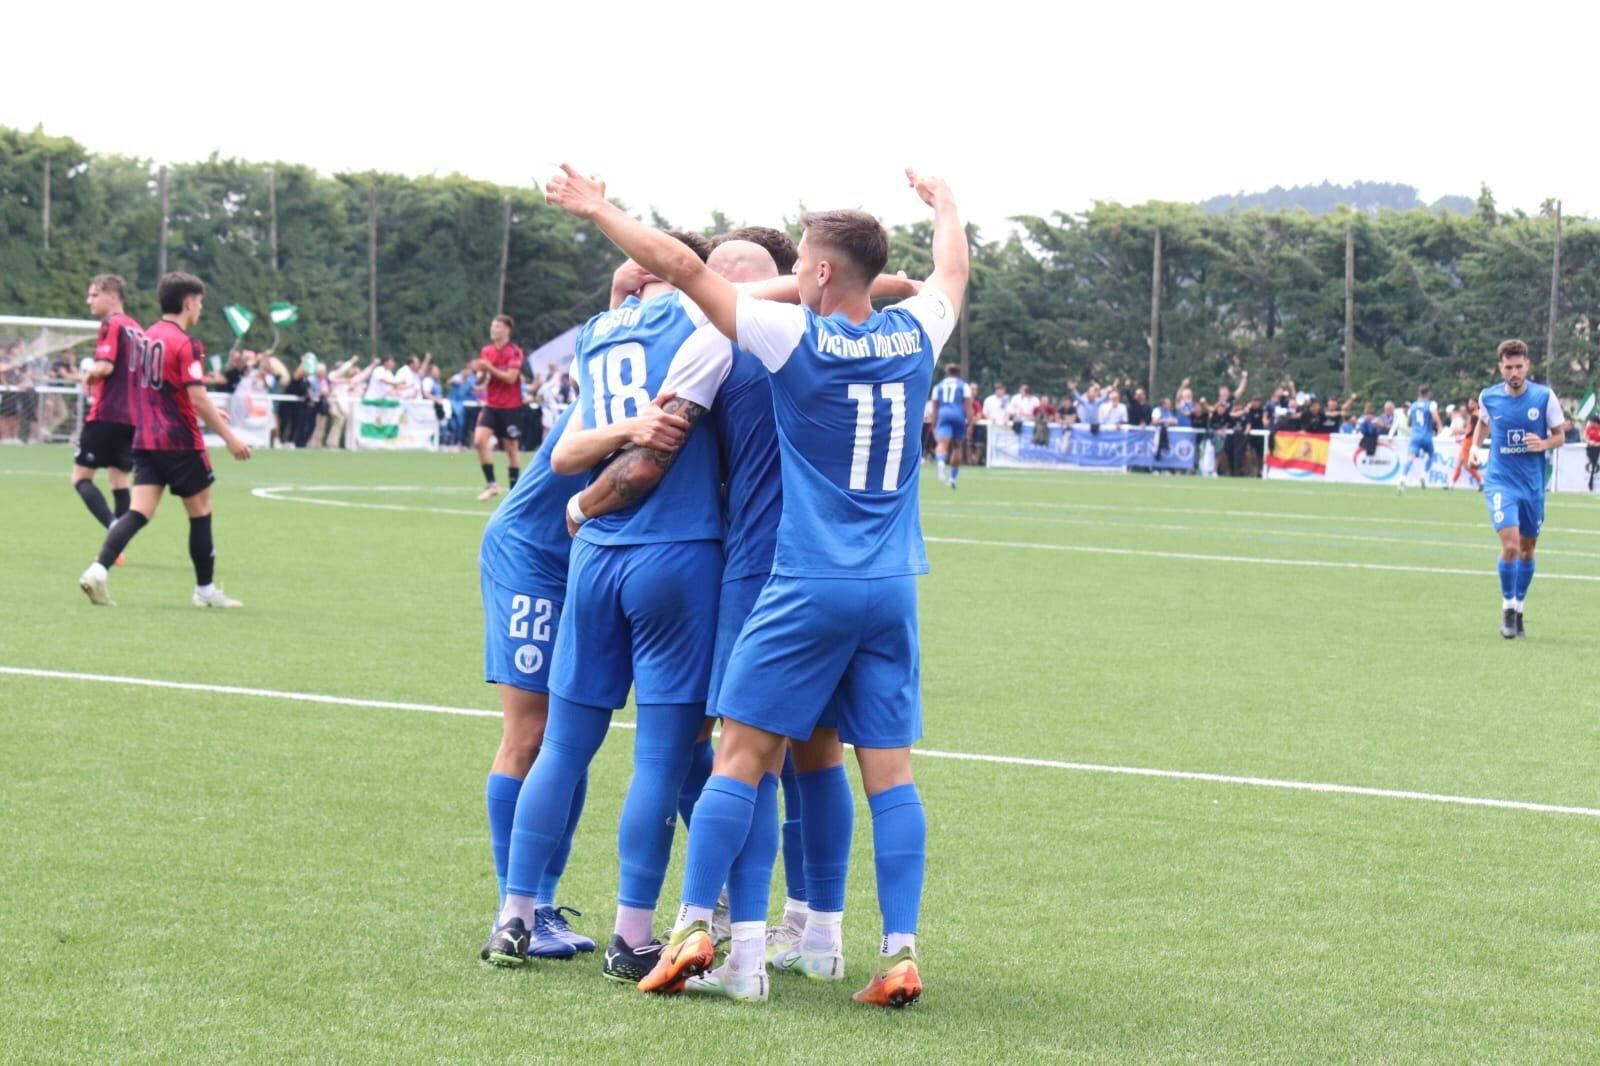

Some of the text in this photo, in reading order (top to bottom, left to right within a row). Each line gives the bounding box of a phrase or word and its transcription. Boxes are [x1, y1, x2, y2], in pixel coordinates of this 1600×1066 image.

[140, 336, 165, 390] 10
[817, 328, 870, 357] VICTOR
[588, 342, 652, 428] 18
[848, 383, 906, 491] 11
[510, 594, 551, 641] 22
